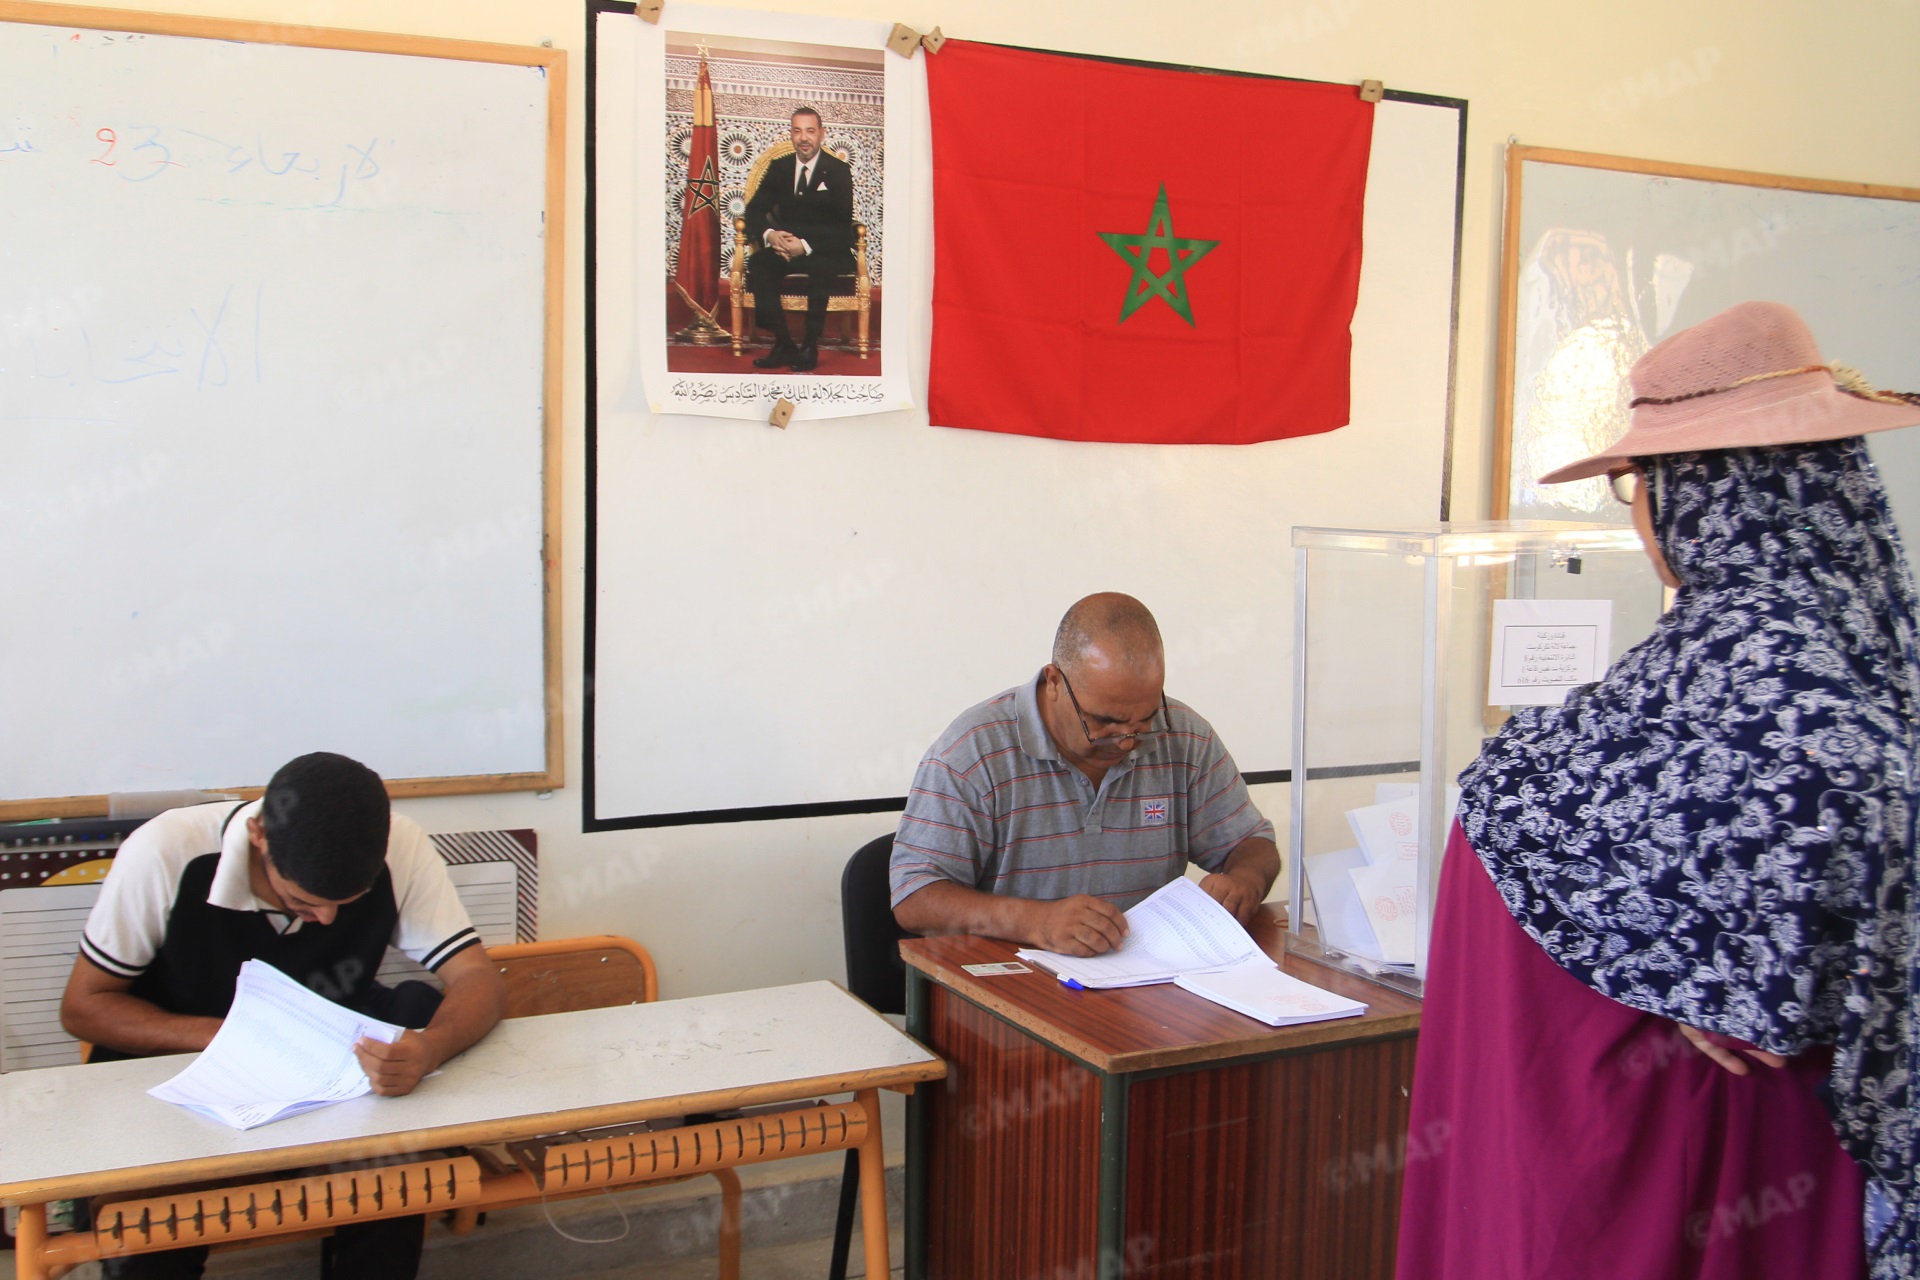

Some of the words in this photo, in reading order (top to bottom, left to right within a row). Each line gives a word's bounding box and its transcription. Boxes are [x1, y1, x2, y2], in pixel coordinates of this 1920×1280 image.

[670, 379, 691, 401] الله
[690, 382, 718, 404] نصره
[718, 382, 761, 405] السادس
[763, 380, 783, 402] محمد
[783, 384, 810, 405] الملك
[812, 382, 849, 404] الجلالة
[847, 383, 884, 404] صاحب
